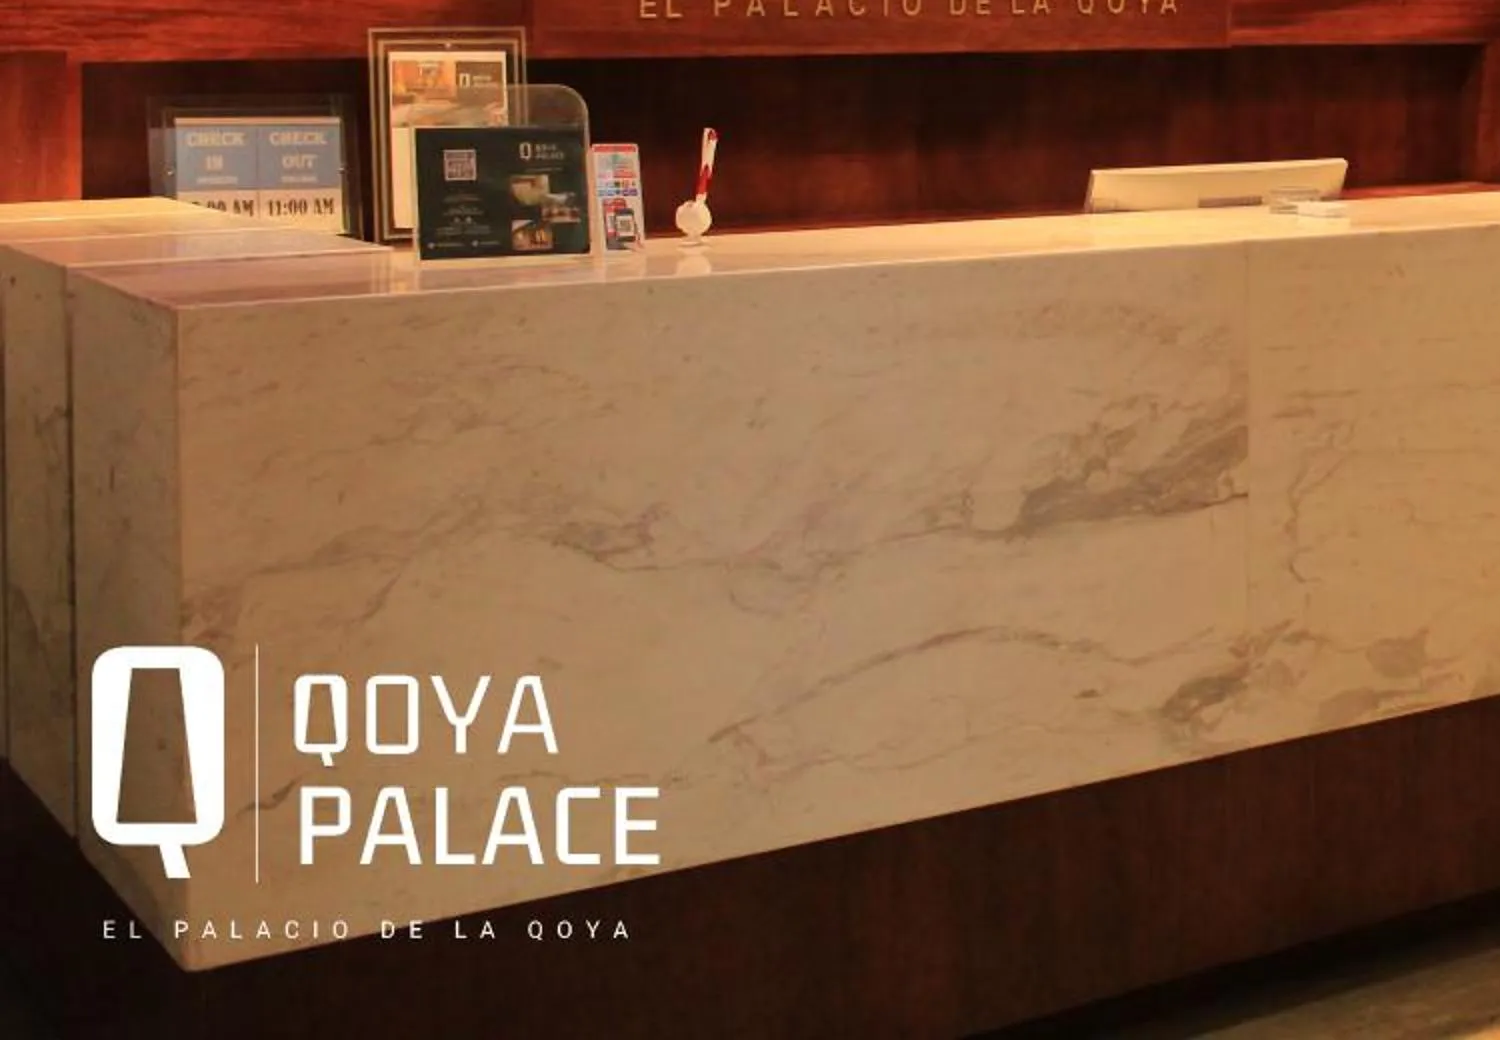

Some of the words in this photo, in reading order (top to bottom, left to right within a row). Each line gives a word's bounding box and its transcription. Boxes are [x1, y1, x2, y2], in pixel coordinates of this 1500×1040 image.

[186, 131, 246, 147] CHECK
[269, 131, 327, 146] CHECK
[206, 154, 224, 171] IN
[281, 154, 318, 169] OUT
[268, 198, 308, 216] 11:00
[313, 197, 334, 215] AM
